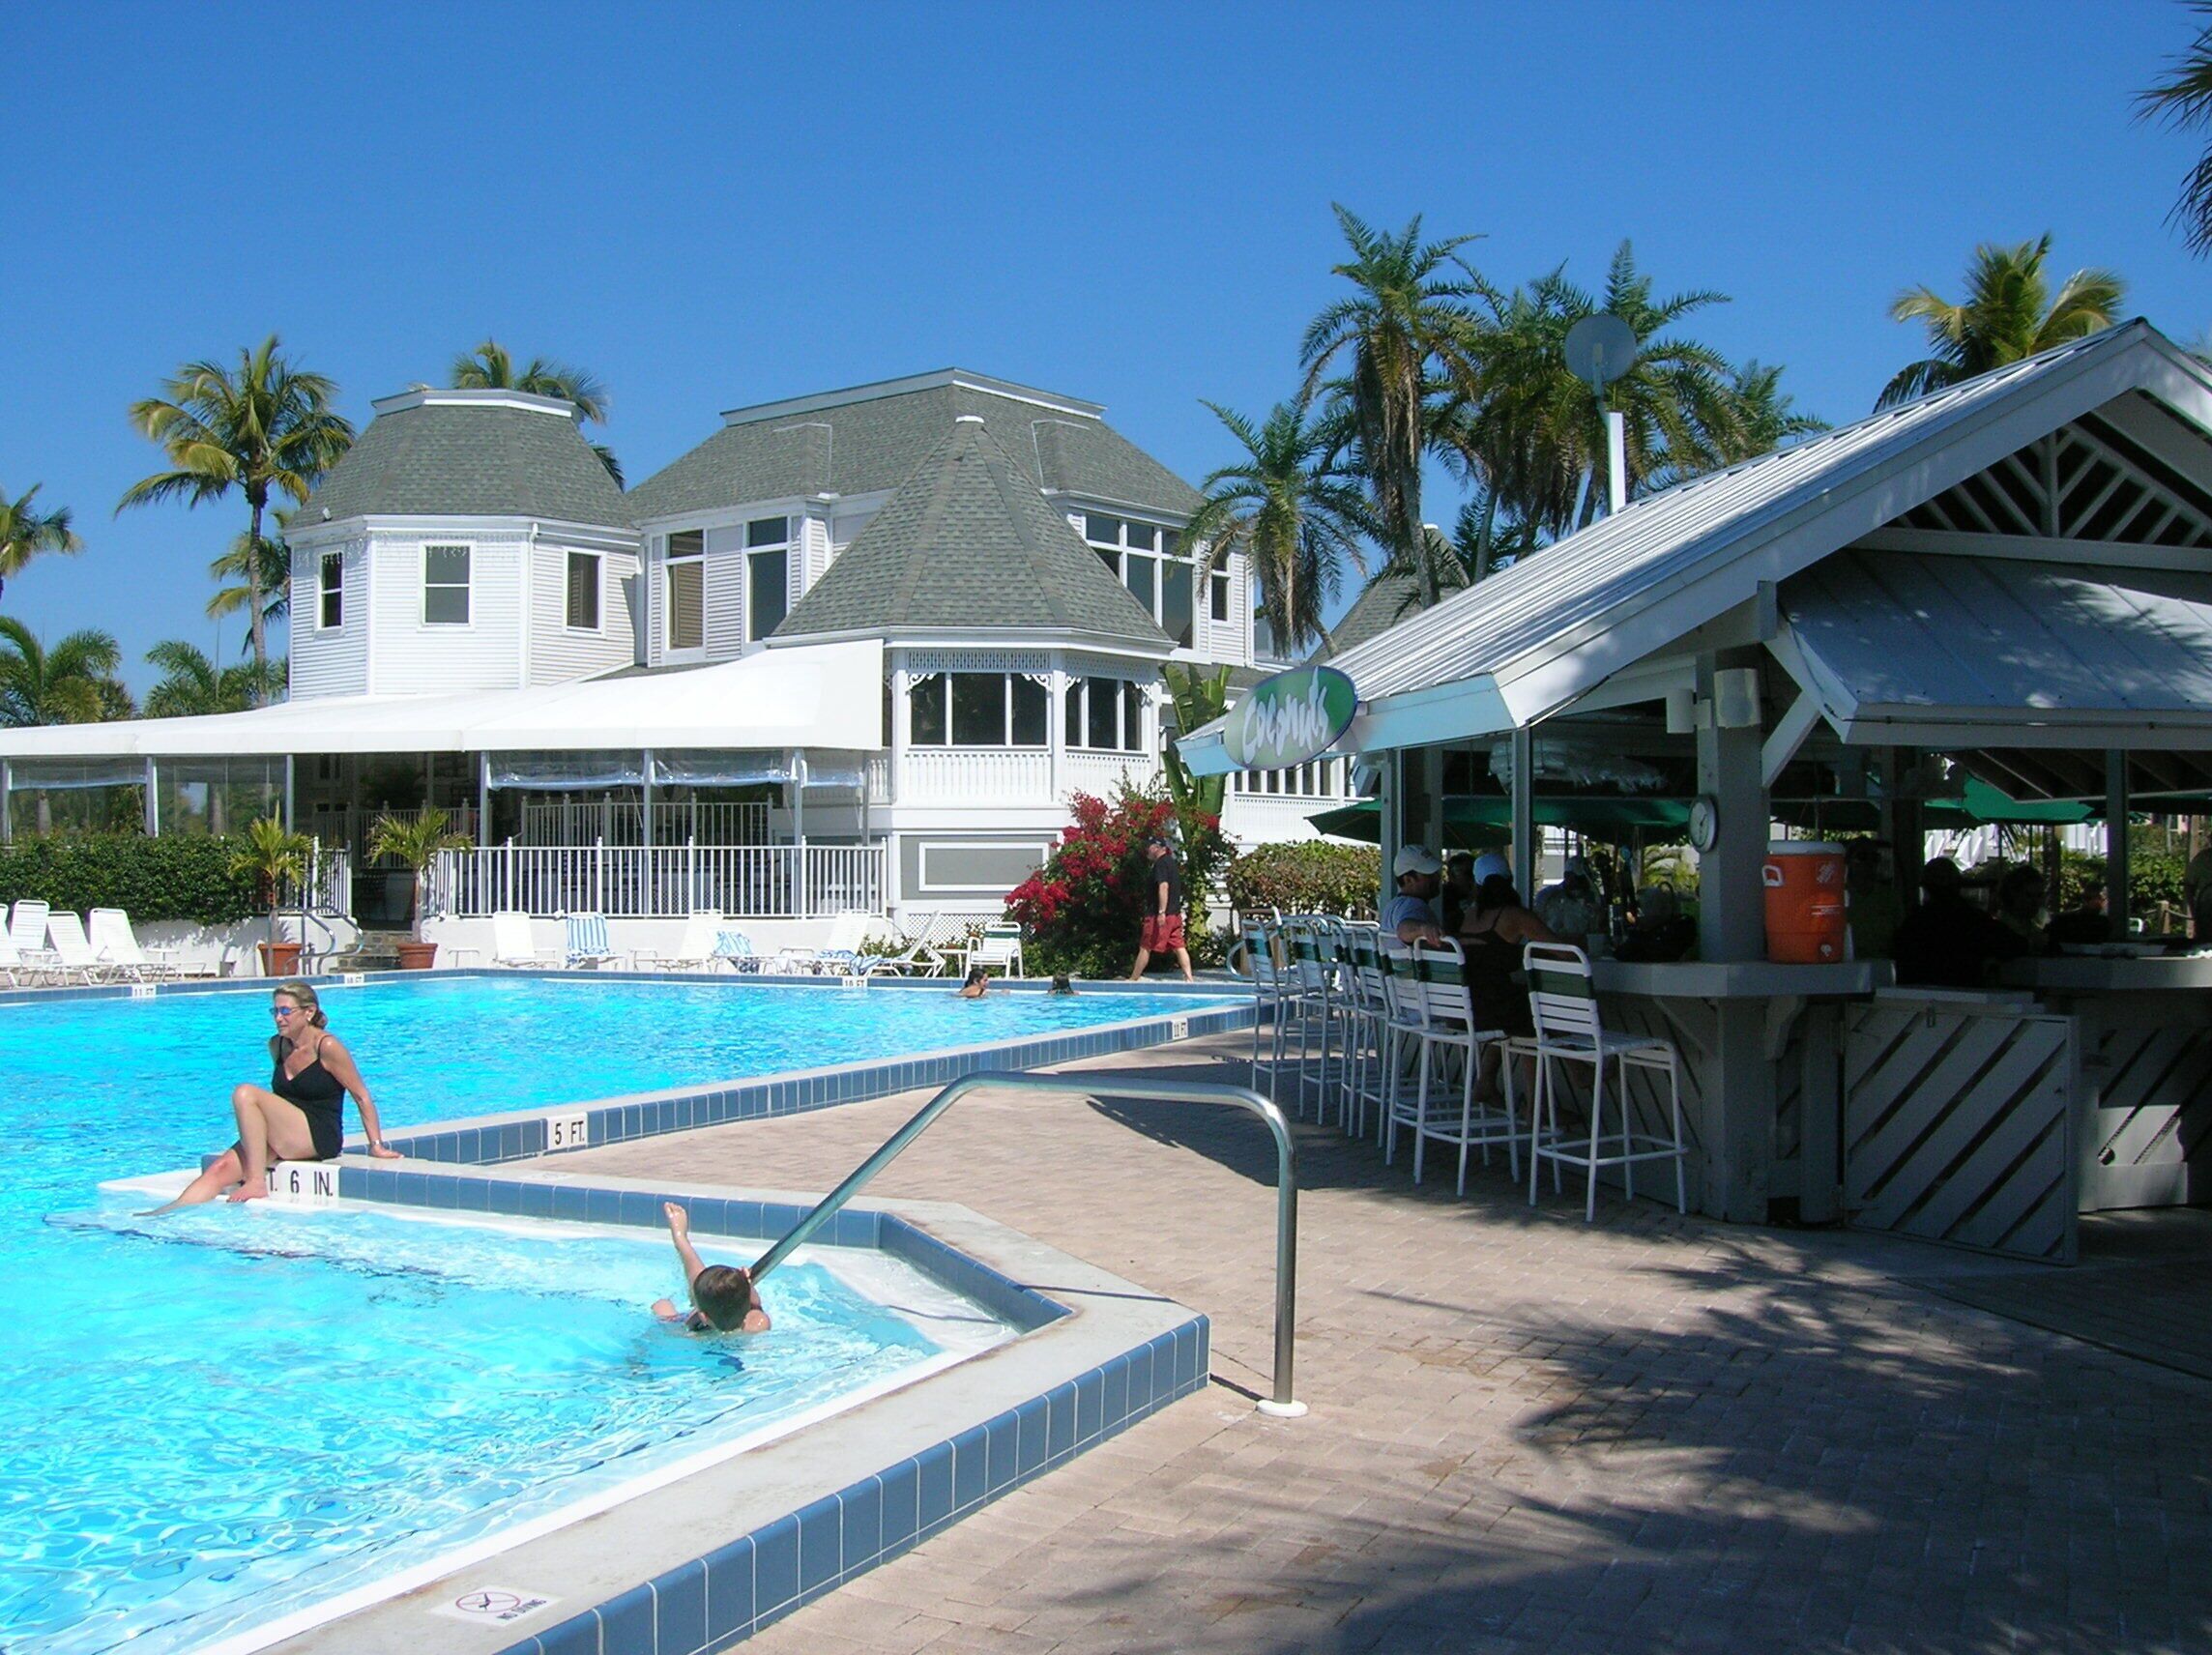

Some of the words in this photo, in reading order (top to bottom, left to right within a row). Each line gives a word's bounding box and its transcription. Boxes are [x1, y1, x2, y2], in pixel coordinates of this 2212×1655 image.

[555, 1122, 562, 1145] 5
[570, 1120, 585, 1144] FT.
[290, 1170, 300, 1194] 6
[313, 1171, 334, 1197] IN.
